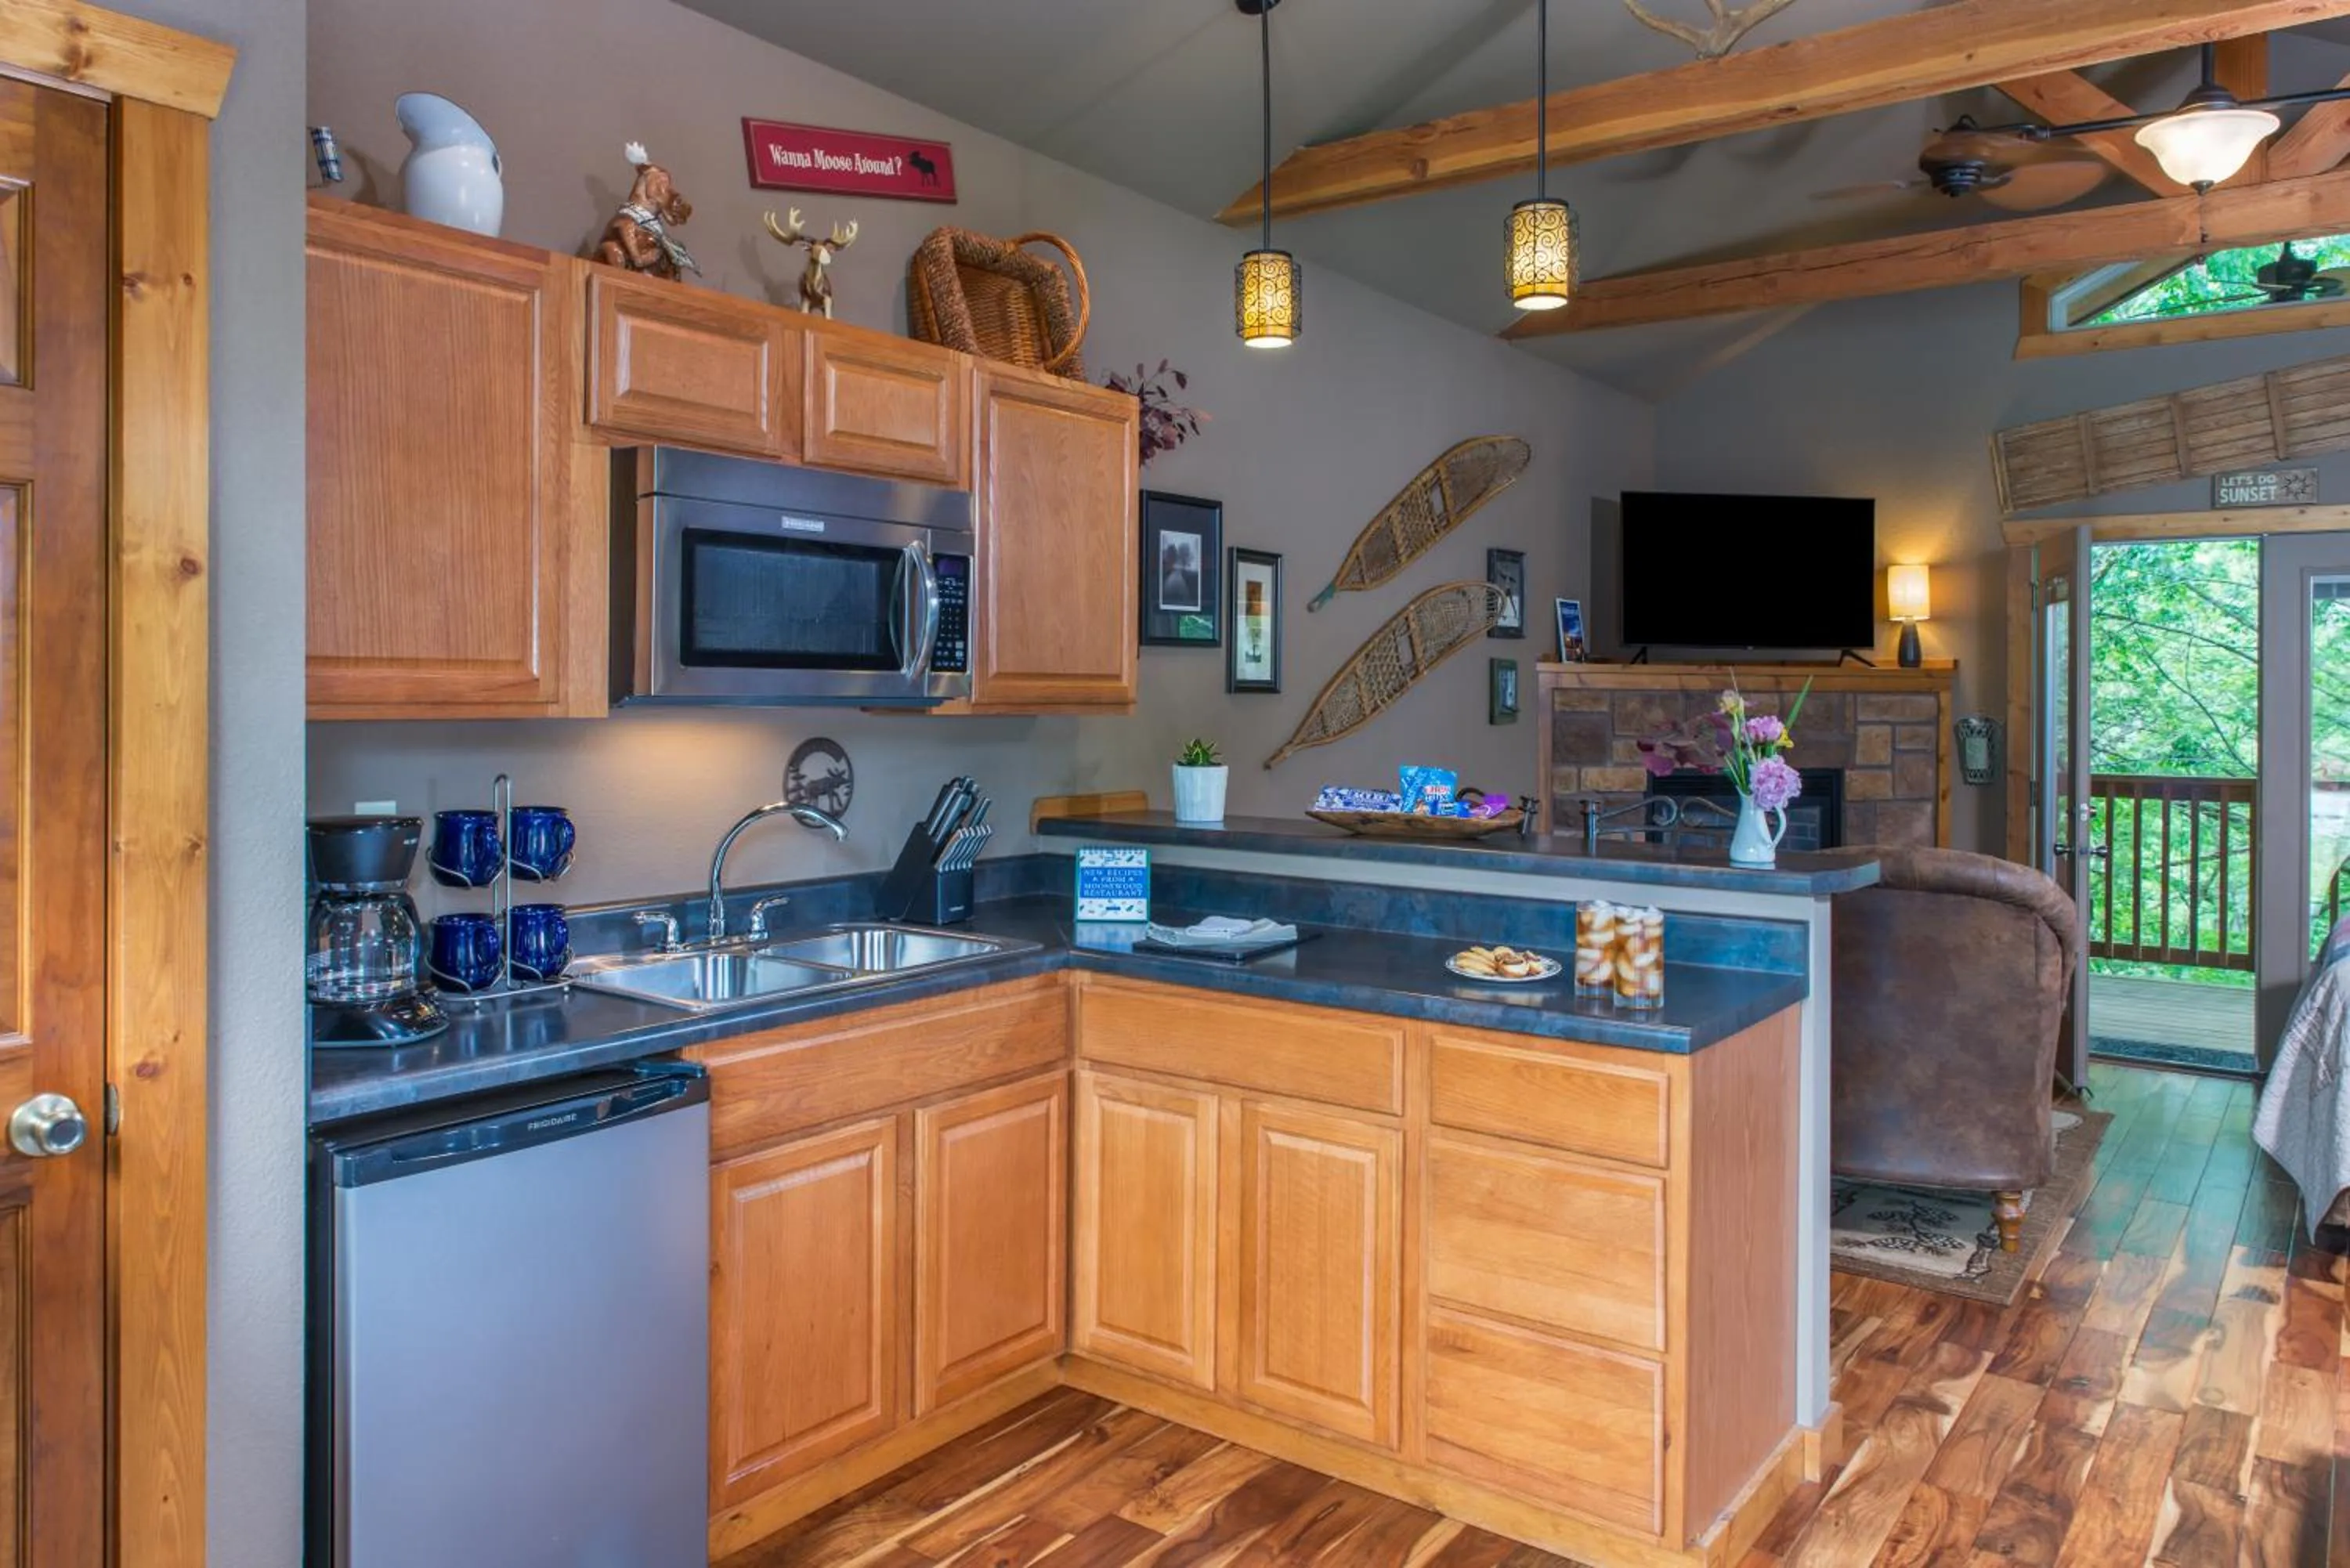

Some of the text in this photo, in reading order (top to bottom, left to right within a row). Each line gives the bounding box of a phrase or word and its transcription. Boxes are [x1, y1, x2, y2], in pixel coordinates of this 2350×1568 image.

[768, 143, 902, 175] Wanna Moose Around?
[2222, 474, 2276, 486] LET'S DO
[2219, 486, 2277, 504] SUNSET
[527, 1113, 577, 1131] FRIGIDAIRE
